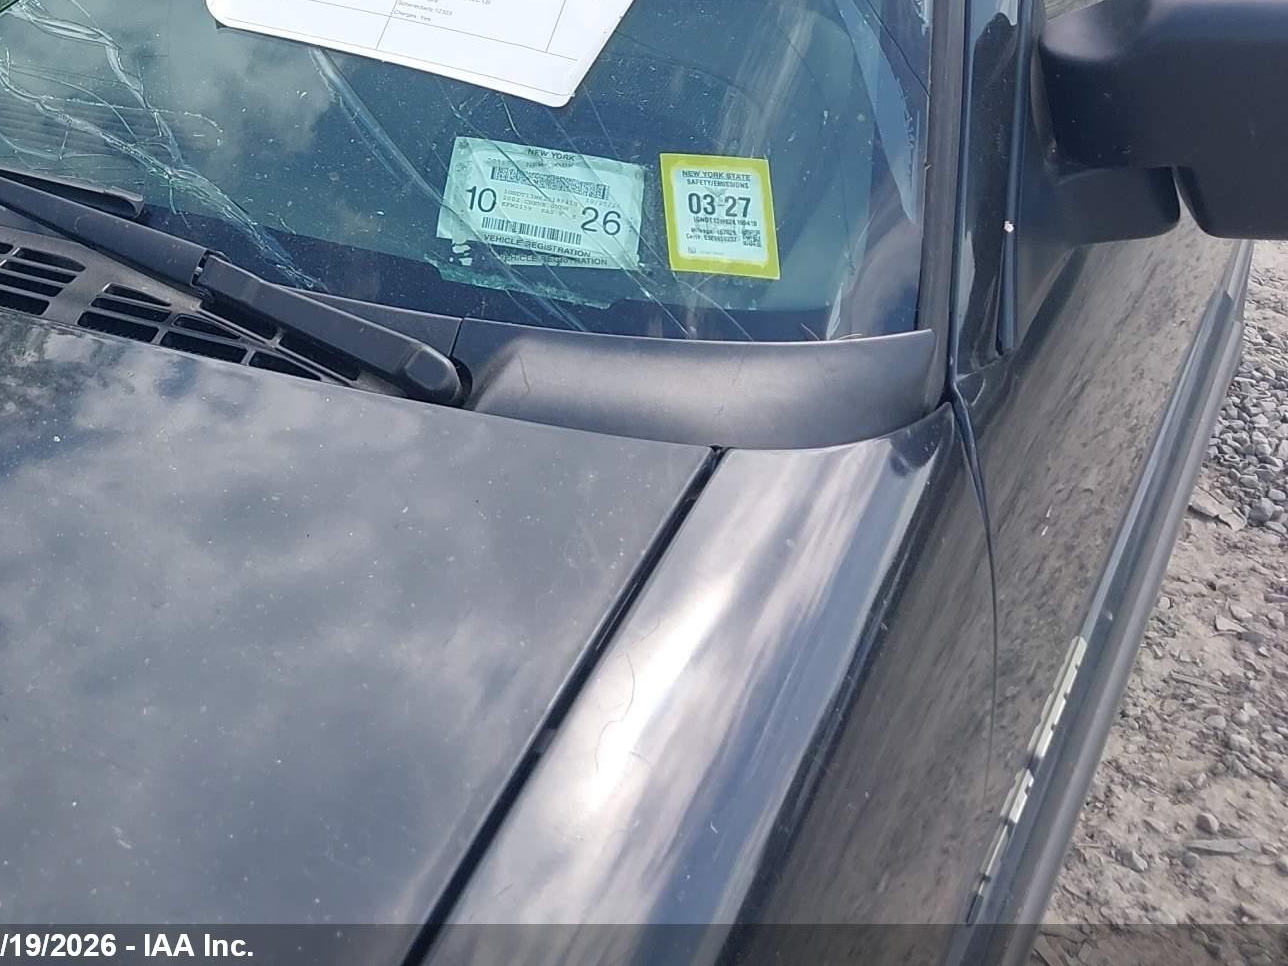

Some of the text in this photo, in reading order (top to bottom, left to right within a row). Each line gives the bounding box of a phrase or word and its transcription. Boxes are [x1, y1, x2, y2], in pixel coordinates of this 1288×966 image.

[527, 147, 577, 162] NEW YORK
[682, 169, 751, 182] NEW YORK STATE
[687, 179, 749, 189] SAFETY/EMISSIONS
[465, 185, 622, 236] 10 26
[484, 233, 524, 245] VEHICLE
